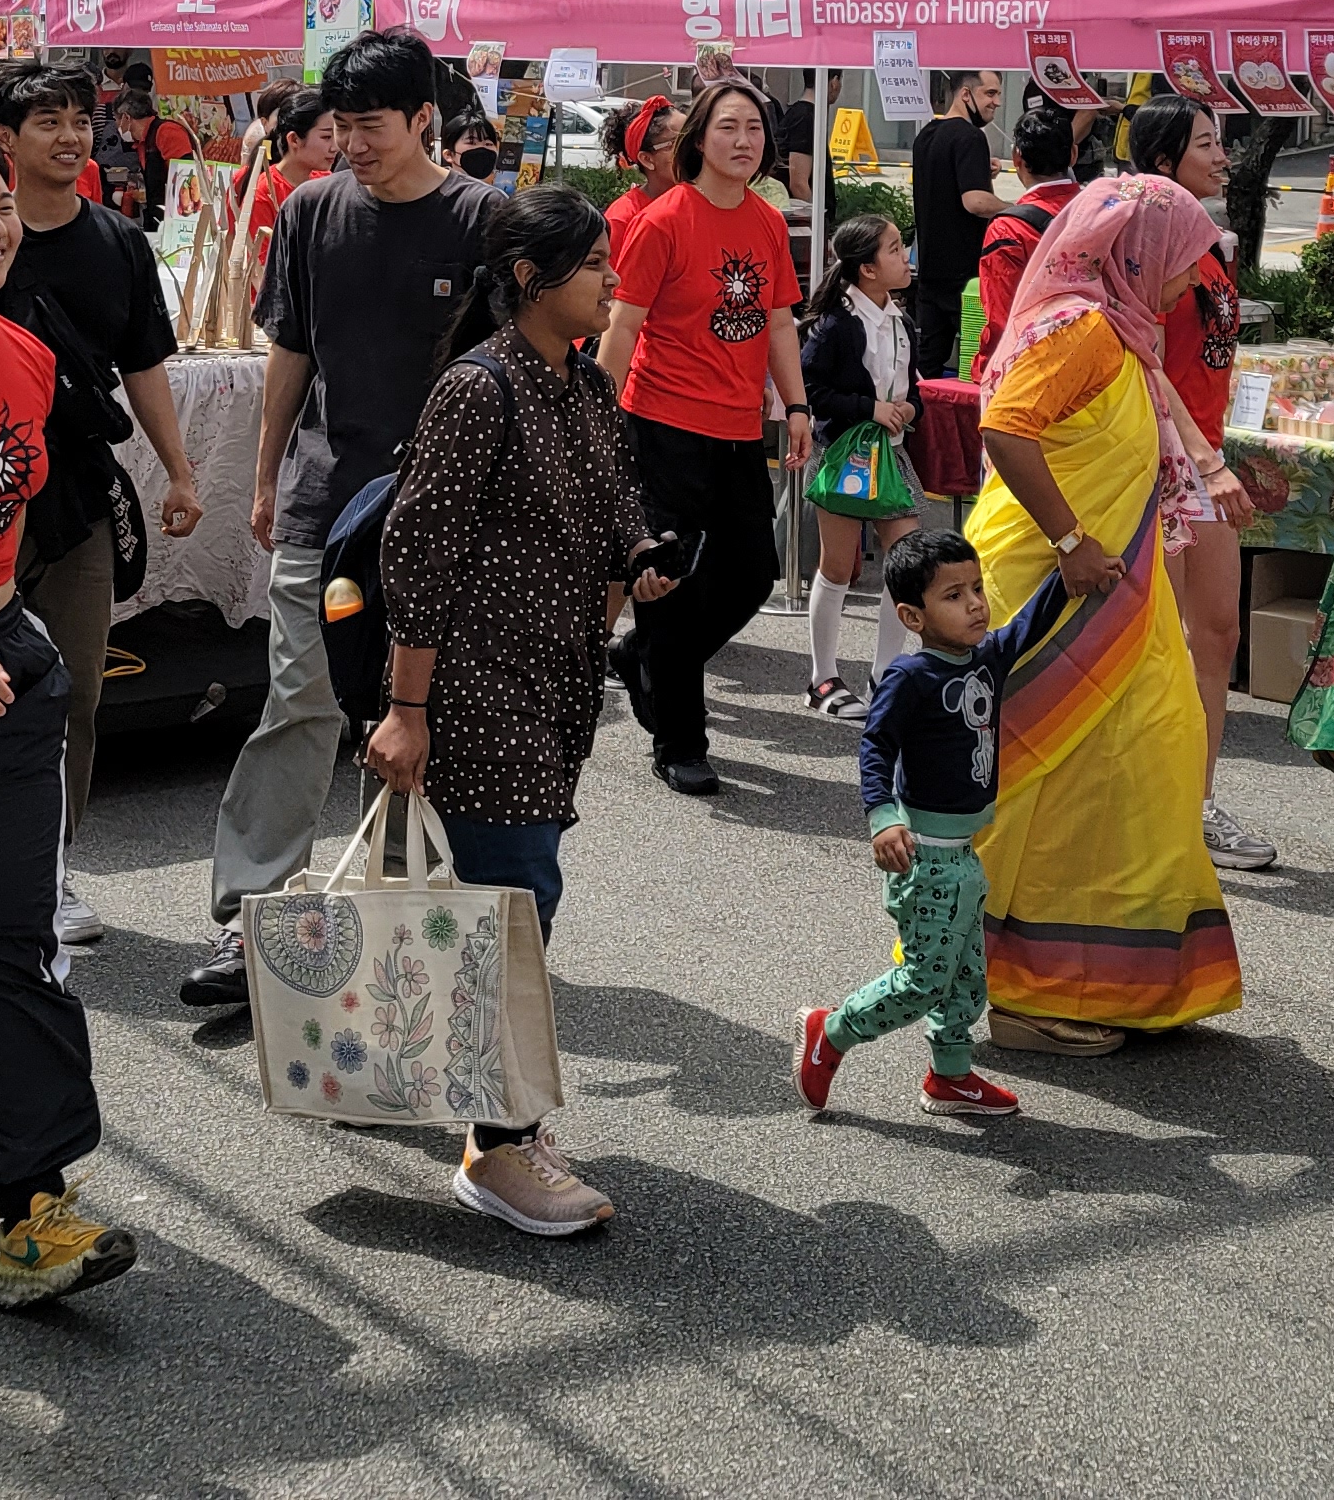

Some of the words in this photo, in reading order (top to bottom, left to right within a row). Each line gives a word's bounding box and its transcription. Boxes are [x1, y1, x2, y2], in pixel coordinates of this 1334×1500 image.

[150, 21, 175, 34] Embassy
[230, 22, 249, 33] Oman
[1262, 35, 1277, 47] 쿠키
[878, 59, 914, 67] 카드결제가능
[205, 62, 244, 82] chicken
[241, 58, 254, 77] &
